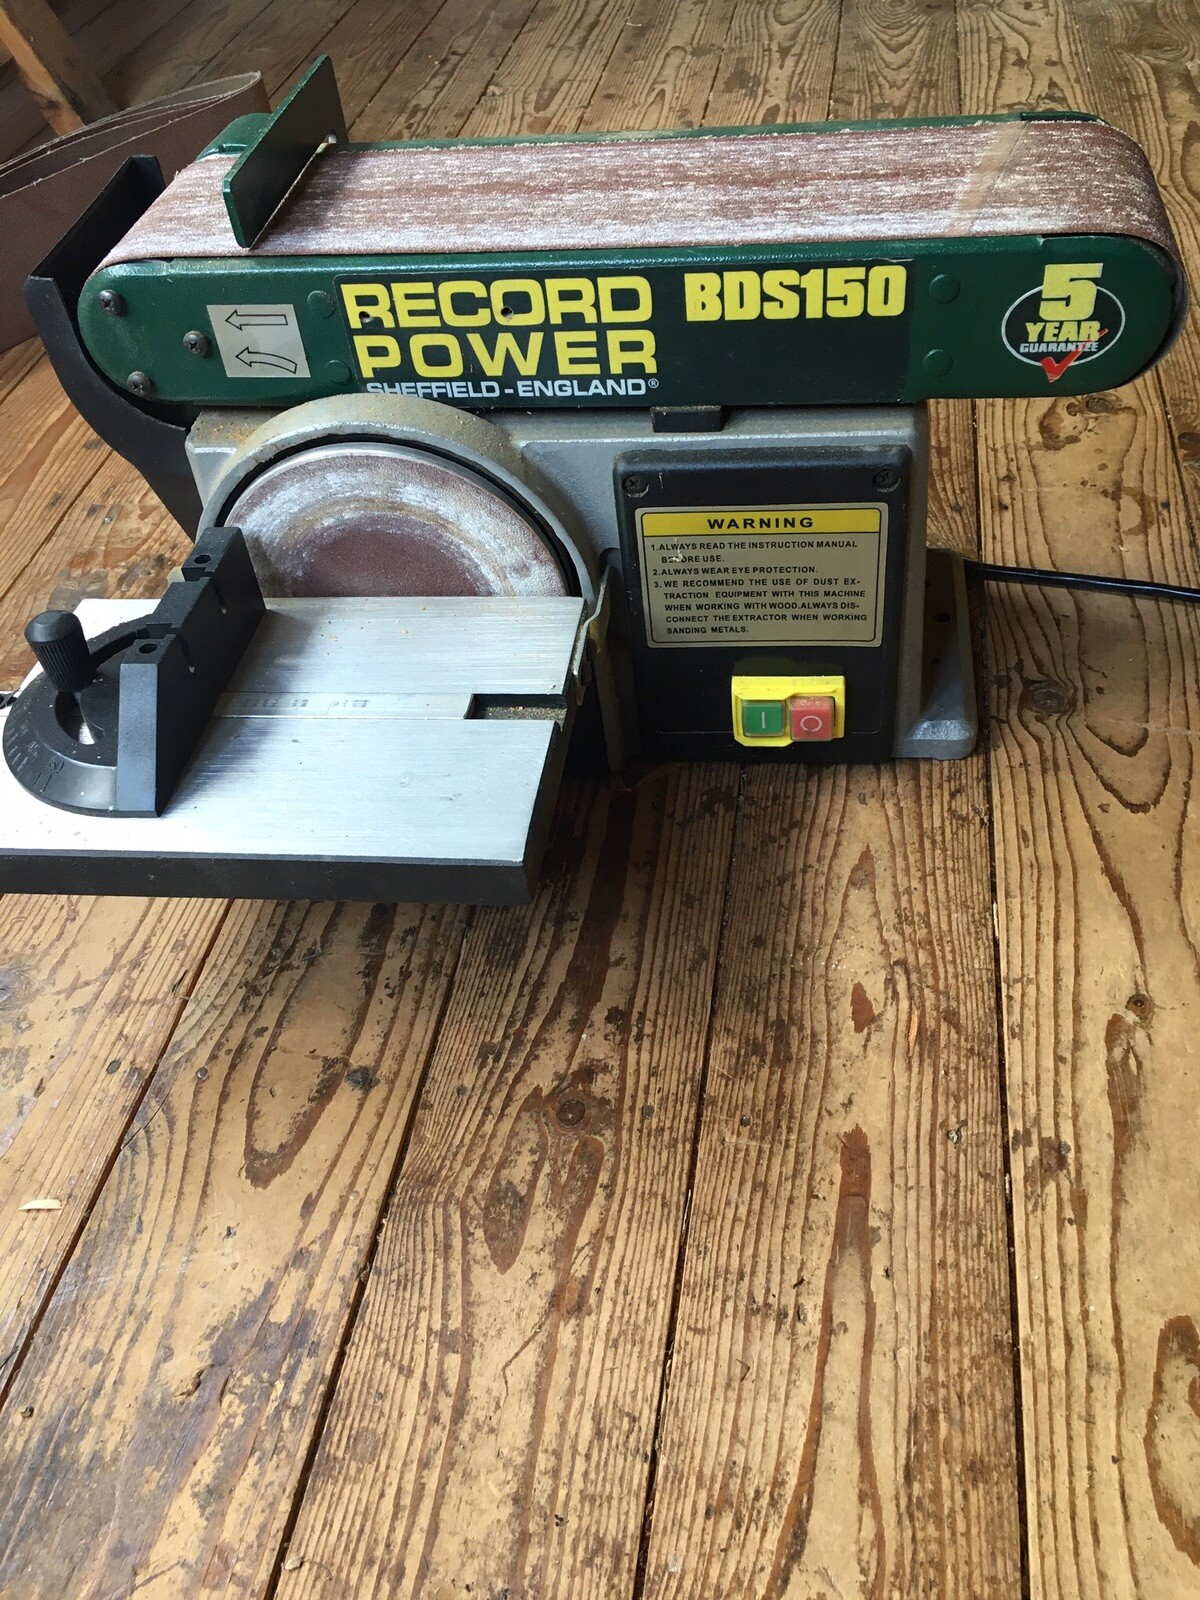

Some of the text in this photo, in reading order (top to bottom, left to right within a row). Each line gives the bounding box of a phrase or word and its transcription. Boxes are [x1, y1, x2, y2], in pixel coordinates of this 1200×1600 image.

[684, 265, 907, 322] BDS150
[1039, 262, 1104, 321] 5
[340, 275, 653, 329] RECORD
[1025, 320, 1101, 343] YEAR
[1019, 341, 1100, 354] GUARANTEE
[353, 329, 658, 379] POWER
[707, 517, 814, 530] WARNING
[699, 542, 726, 550] READ
[727, 542, 746, 550] THE
[748, 541, 814, 549] INSTRUCTION
[816, 540, 858, 548] MANUAL
[702, 554, 725, 563] USE.
[701, 567, 730, 575] WEAR
[731, 566, 750, 574] EYE
[752, 566, 818, 574] PROTECTION.
[663, 580, 678, 588] WE
[682, 578, 745, 588] RECOMMEND
[748, 578, 768, 586] THE
[771, 578, 791, 586] USE
[795, 578, 808, 586] OF
[813, 578, 840, 586] DUST
[843, 577, 861, 585] EX-
[663, 590, 866, 600] TRACTION EQUIPMENT WITH THIS MACHINE
[664, 604, 692, 612] WHEN
[695, 602, 740, 611] WORKING
[743, 602, 767, 610] WITH
[840, 602, 860, 610] DIS-
[665, 615, 709, 623] CONNECT
[712, 614, 731, 622] THE
[732, 614, 788, 622] EXTRACTOR
[666, 626, 749, 635] SANDING METALS.
